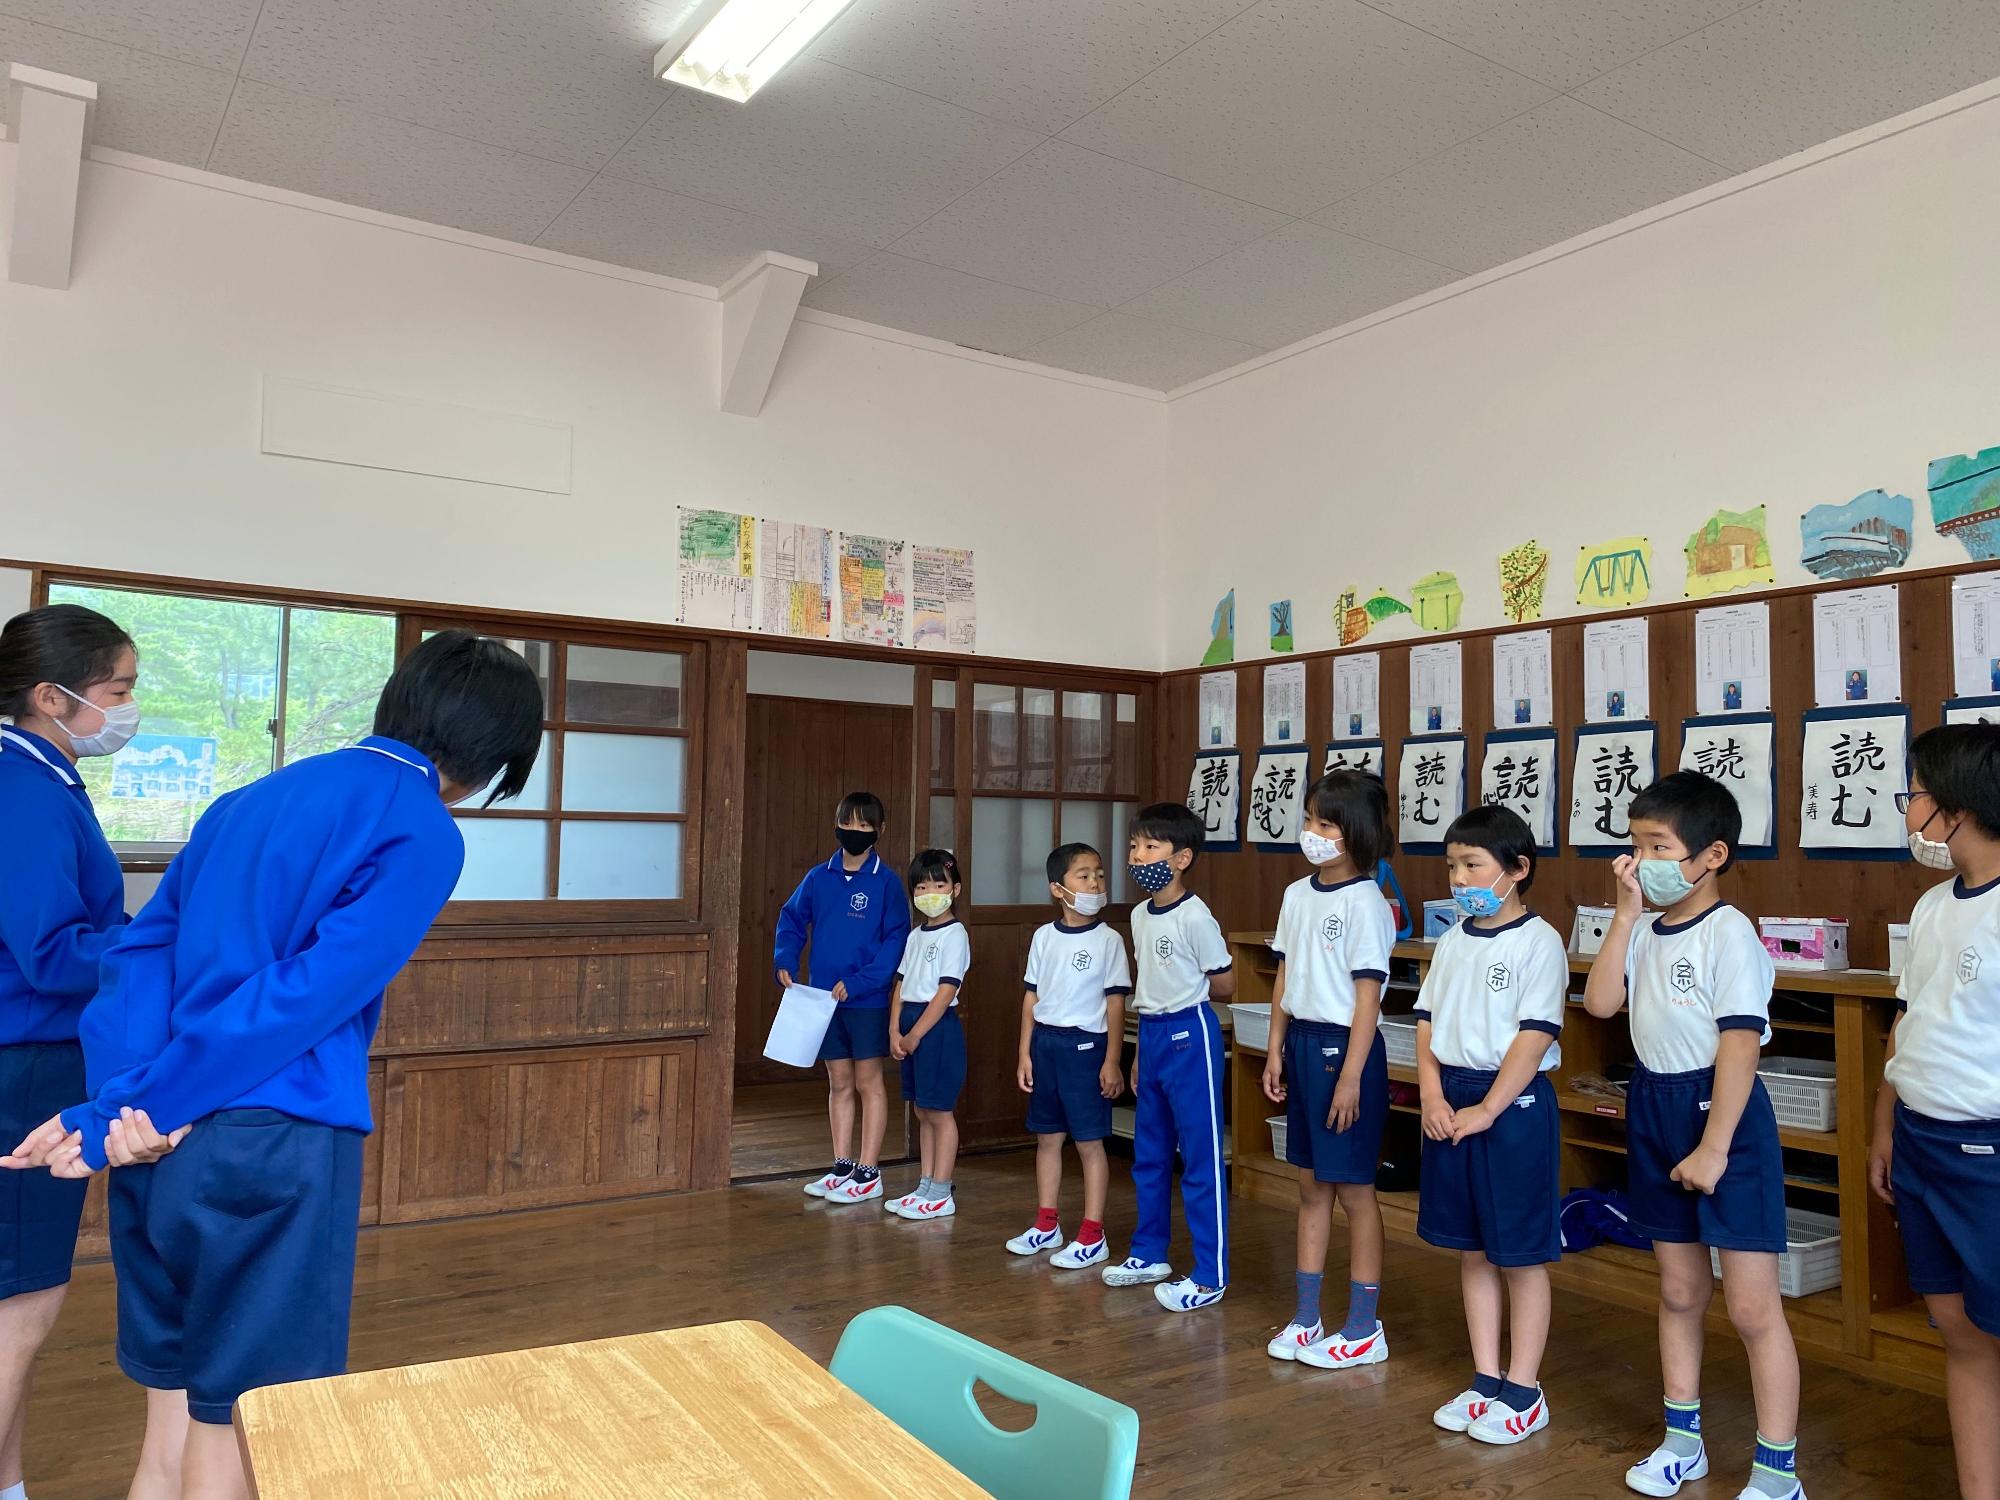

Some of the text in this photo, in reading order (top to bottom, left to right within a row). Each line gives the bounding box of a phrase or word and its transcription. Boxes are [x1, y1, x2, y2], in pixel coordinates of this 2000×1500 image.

[743, 518, 752, 575] もち米新聞
[1414, 752, 1447, 825] 読む
[1592, 745, 1642, 838] 読む
[1693, 738, 1746, 779] 読
[1829, 731, 1886, 828] 読む
[1198, 759, 1230, 832] 読む
[1263, 765, 1296, 839] 読む
[1573, 799, 1581, 818] るの
[1806, 783, 1818, 820] 美寿
